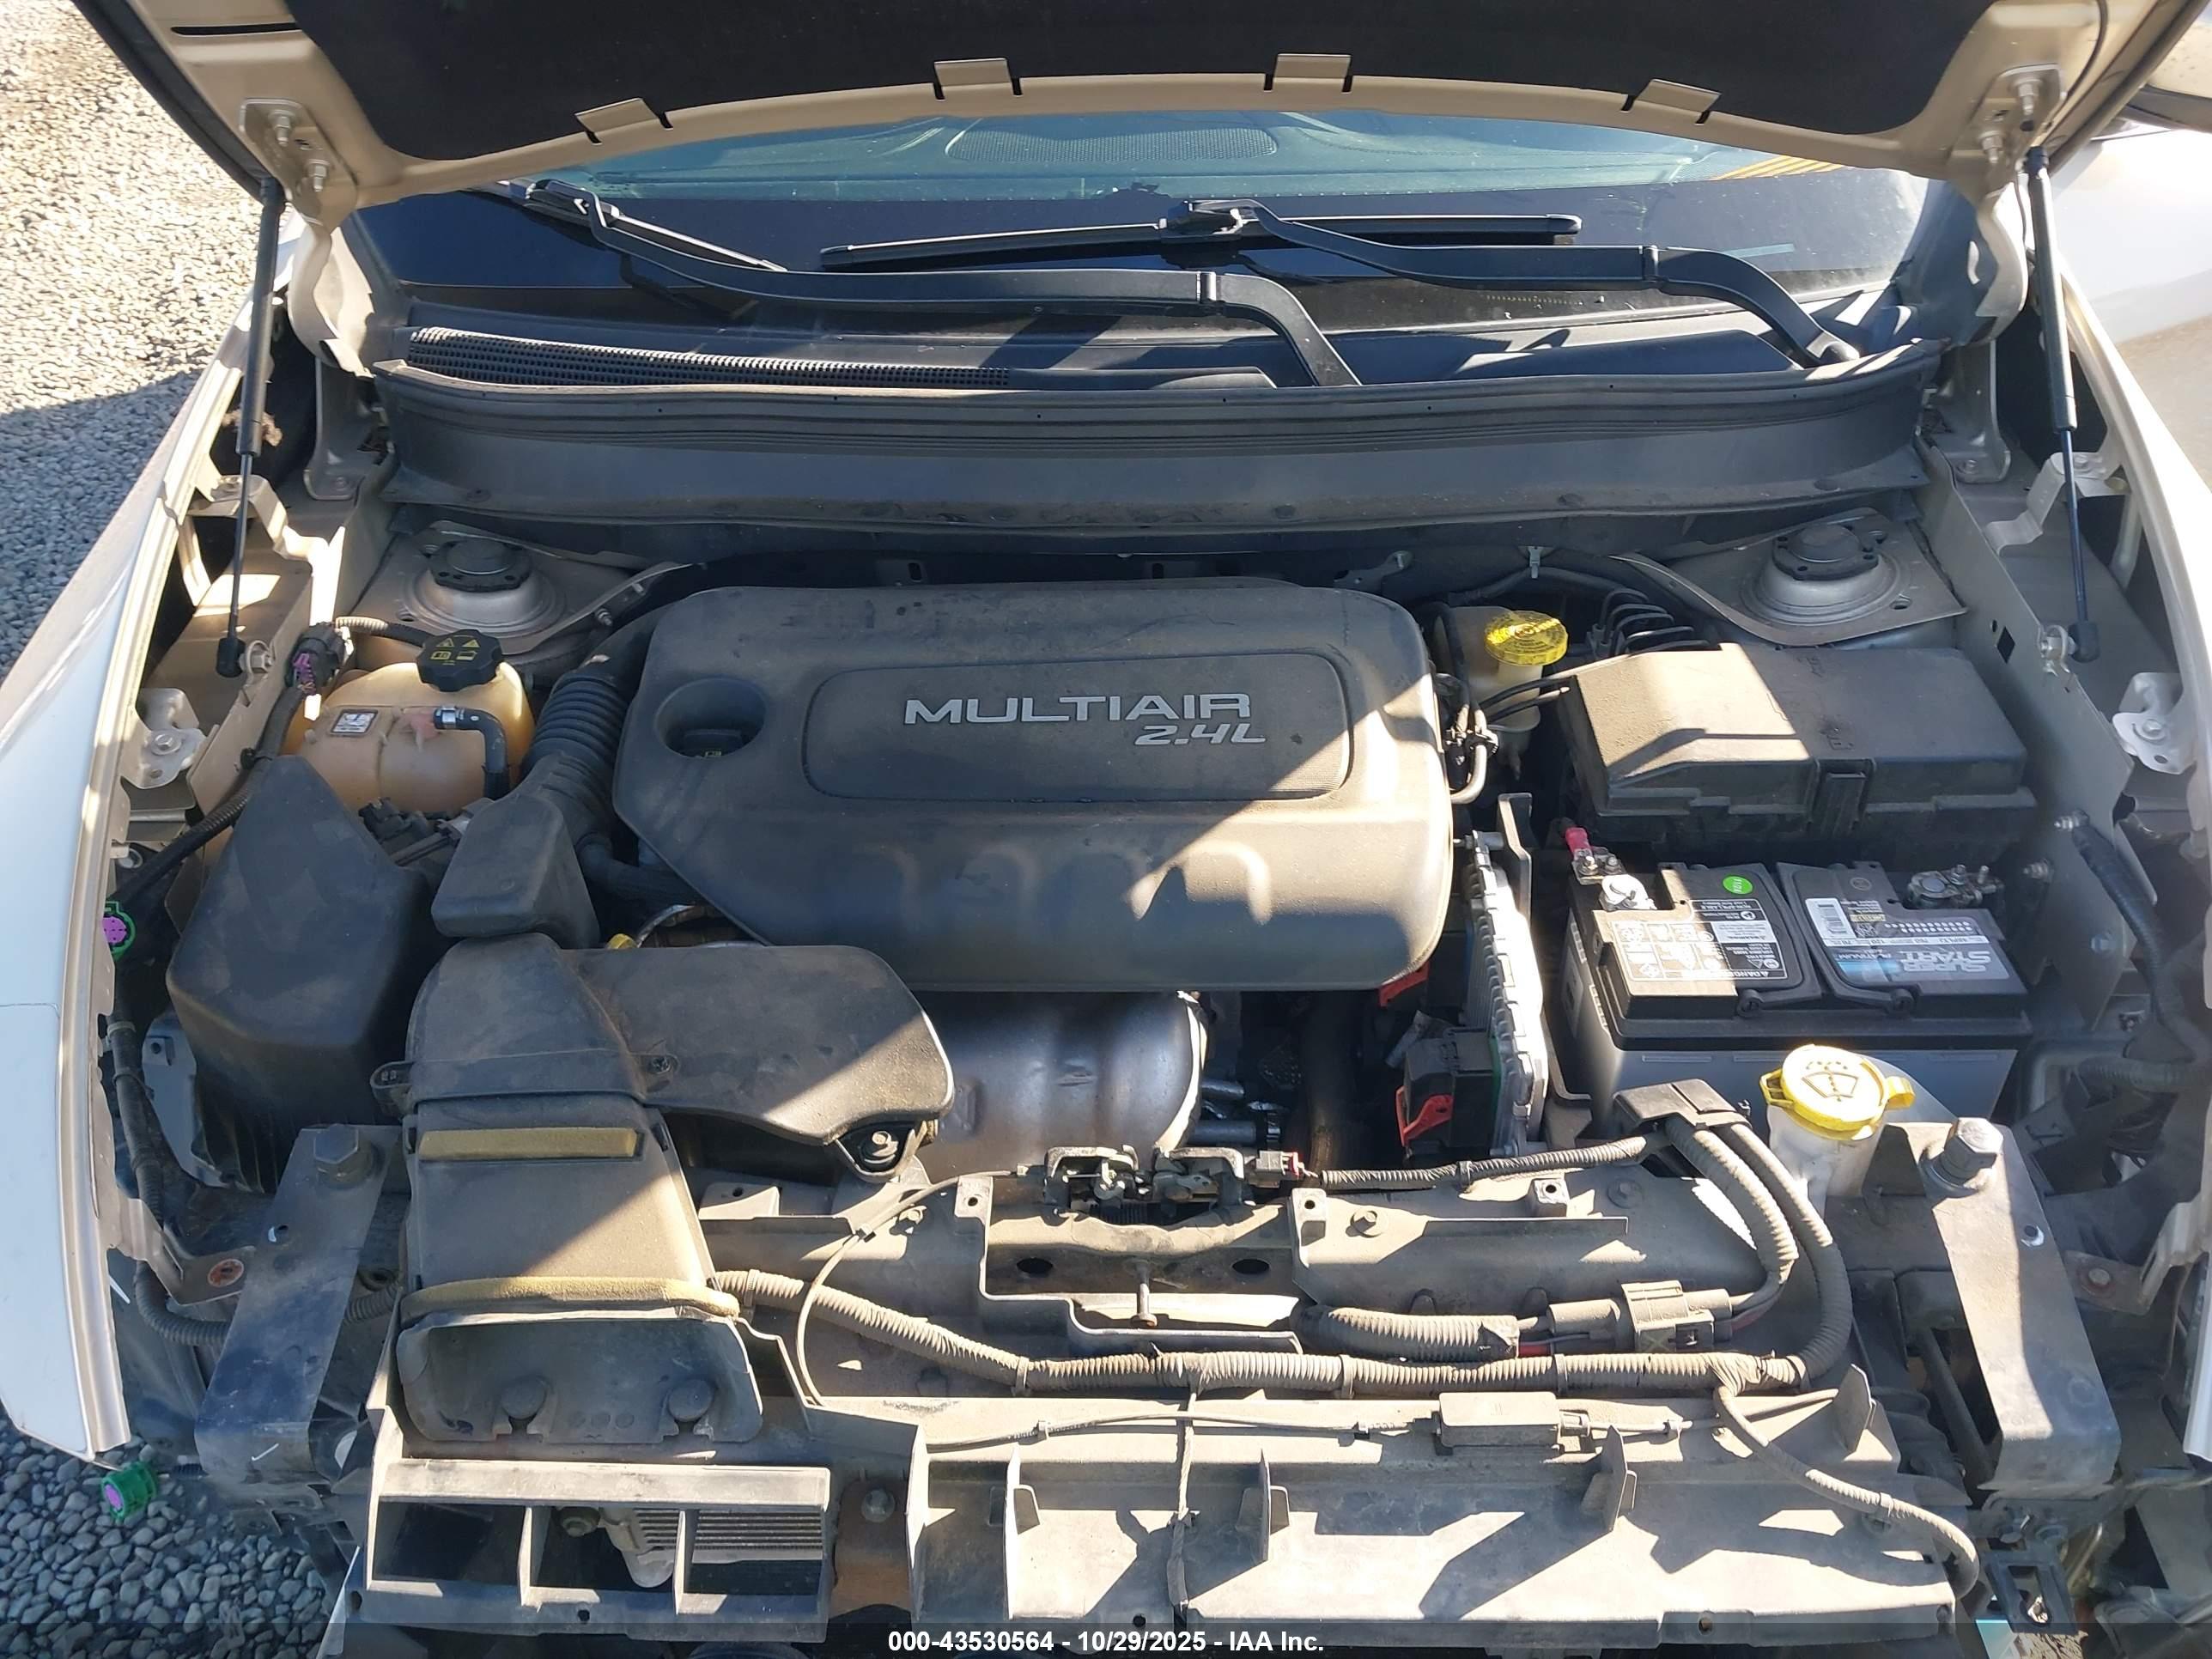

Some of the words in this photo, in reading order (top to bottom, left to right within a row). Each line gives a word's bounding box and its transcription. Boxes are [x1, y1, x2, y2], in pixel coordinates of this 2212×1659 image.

[904, 693, 1251, 725] MULTIAIR
[1133, 722, 1266, 745] 2.4L
[1899, 951, 1990, 963] START
[1903, 961, 1987, 973] SUPER
